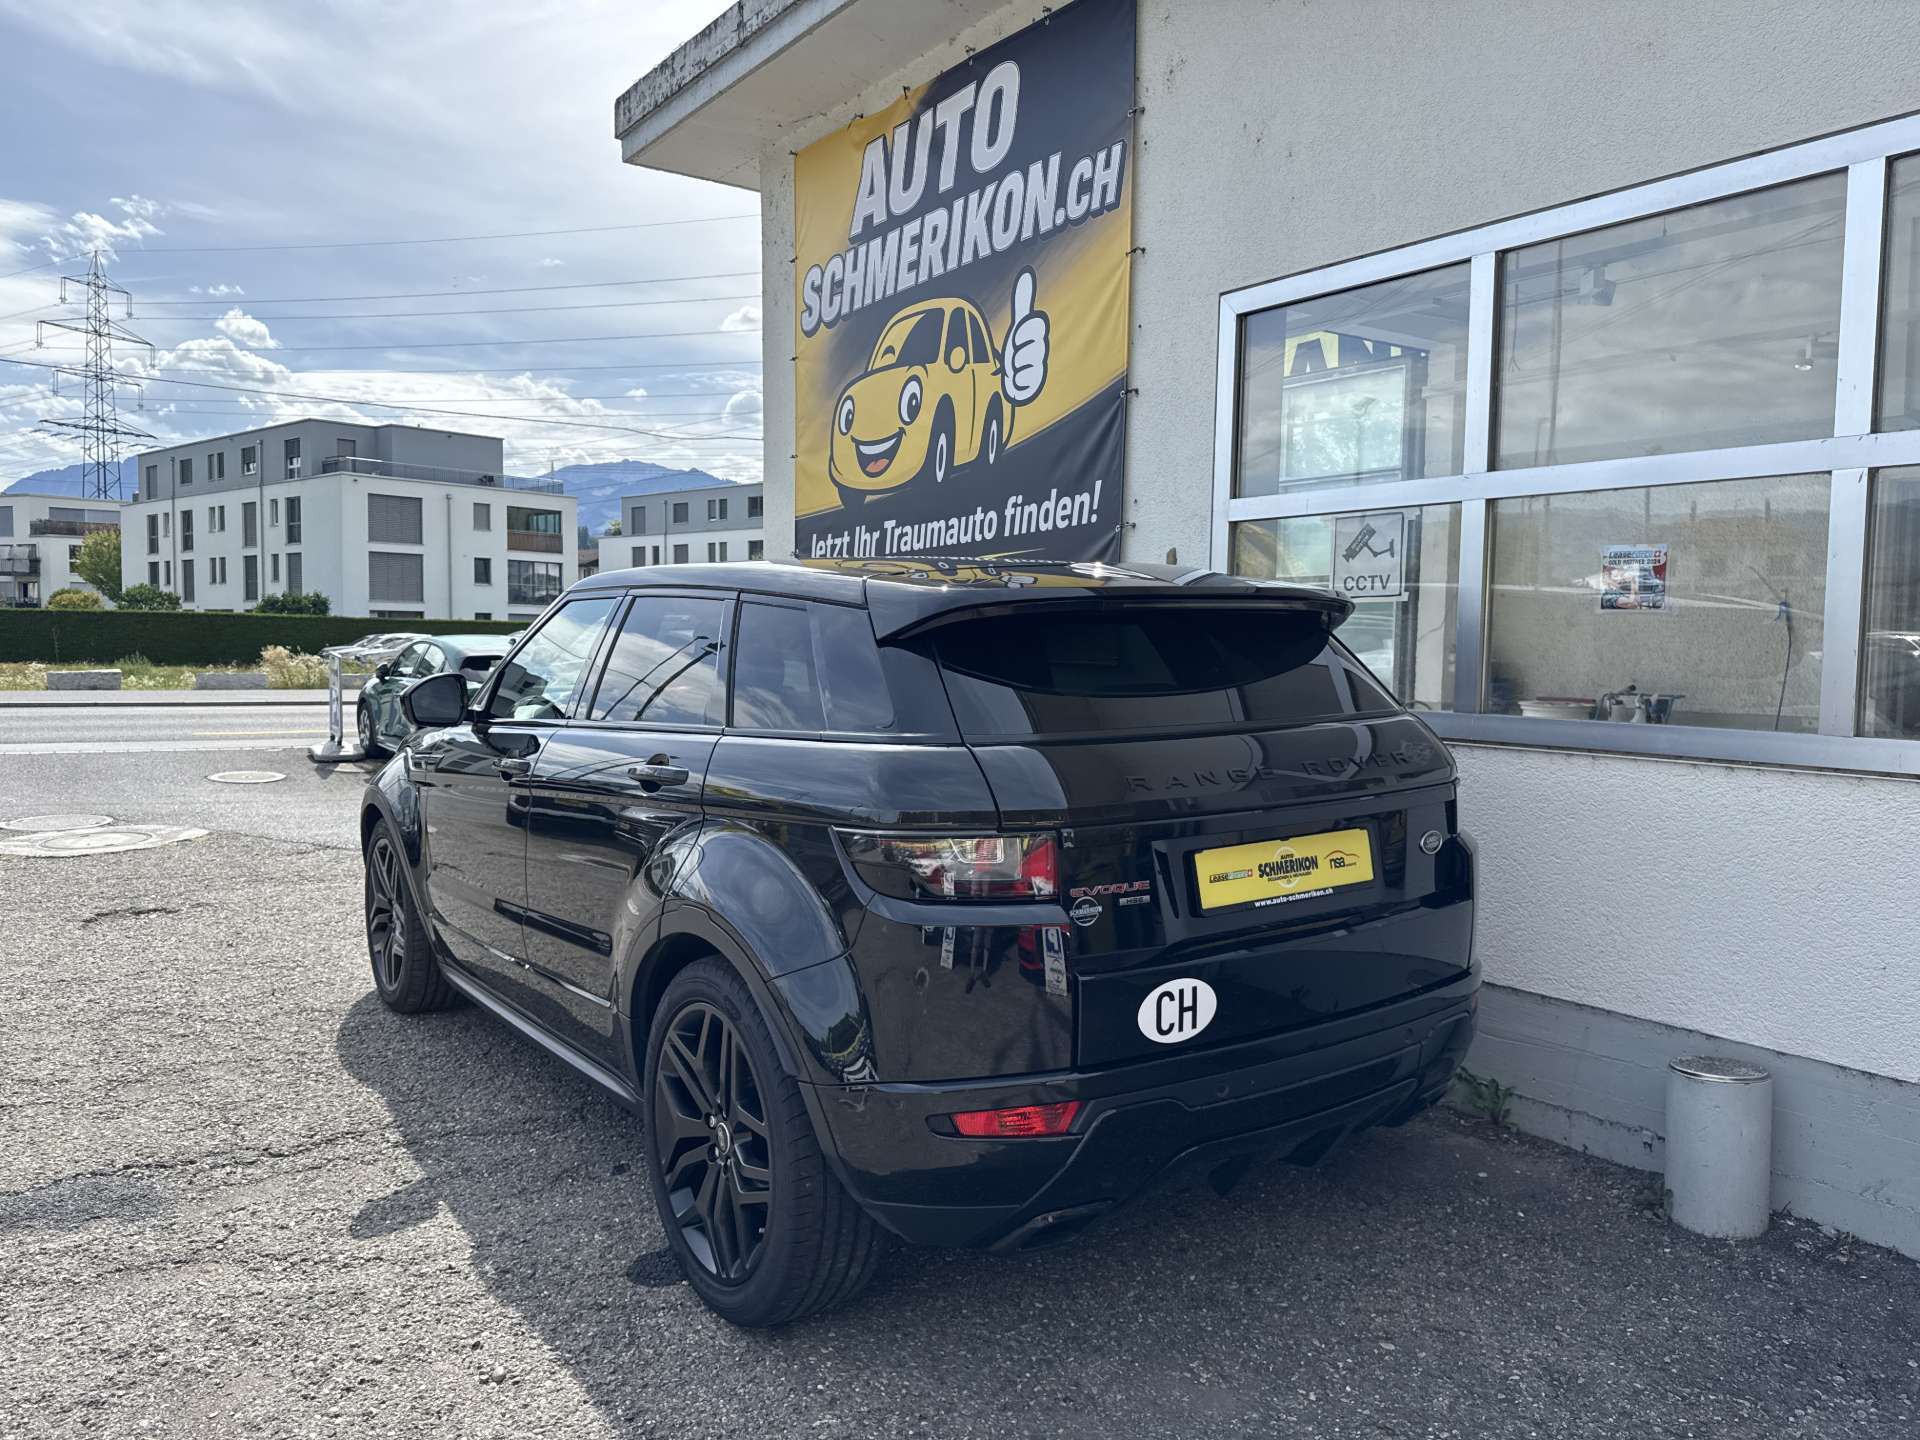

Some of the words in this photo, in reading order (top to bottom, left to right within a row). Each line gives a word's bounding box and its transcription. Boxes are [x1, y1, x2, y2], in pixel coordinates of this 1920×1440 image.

[850, 60, 1020, 237] AUTO
[801, 142, 1124, 331] SCHMERIKON.CH
[854, 526, 880, 558] Ihr
[883, 506, 997, 555] Traumauto
[1004, 480, 1102, 537] finden!
[1343, 574, 1391, 592] CCTV
[1124, 767, 1276, 793] RANGE
[1300, 751, 1409, 777] ROVER
[1070, 880, 1151, 898] EVOQUE
[1258, 855, 1319, 879] SCHMERIKON
[1154, 985, 1199, 1037] CH
